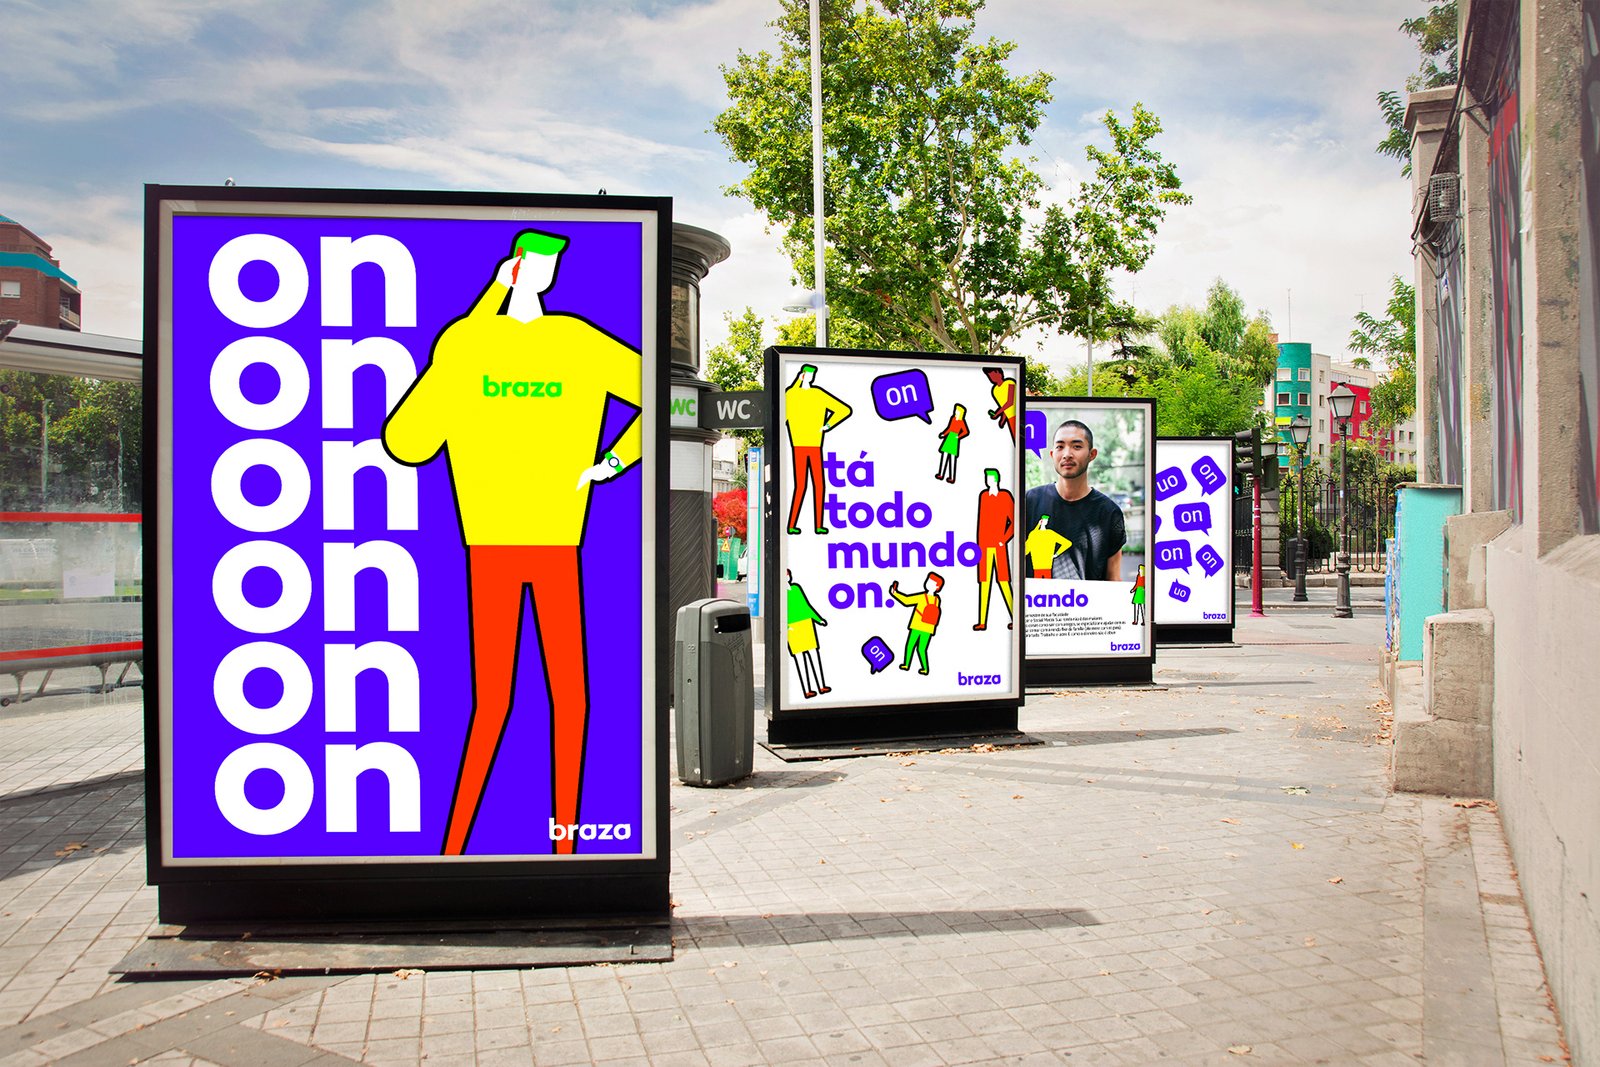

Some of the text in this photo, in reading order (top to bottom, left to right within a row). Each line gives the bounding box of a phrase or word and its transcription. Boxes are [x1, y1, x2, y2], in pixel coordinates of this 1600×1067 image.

[208, 233, 417, 329] on
[209, 335, 418, 431] on
[482, 374, 563, 399] braza
[885, 382, 918, 407] on
[670, 398, 696, 417] WC
[716, 399, 751, 421] WC
[822, 450, 875, 488] tá
[1199, 463, 1218, 485] on
[210, 438, 419, 533] on
[823, 490, 933, 529] todo
[1180, 509, 1203, 524] on
[827, 530, 982, 569] mundo
[1160, 547, 1183, 562] on
[1201, 550, 1217, 569] on
[211, 539, 420, 634] on
[827, 581, 895, 610] on.
[1202, 611, 1227, 620] braza
[869, 644, 886, 663] on
[1110, 641, 1141, 652] braza
[213, 640, 421, 735] on
[957, 671, 1002, 686] braza
[214, 741, 421, 836] on
[548, 817, 632, 842] braza
